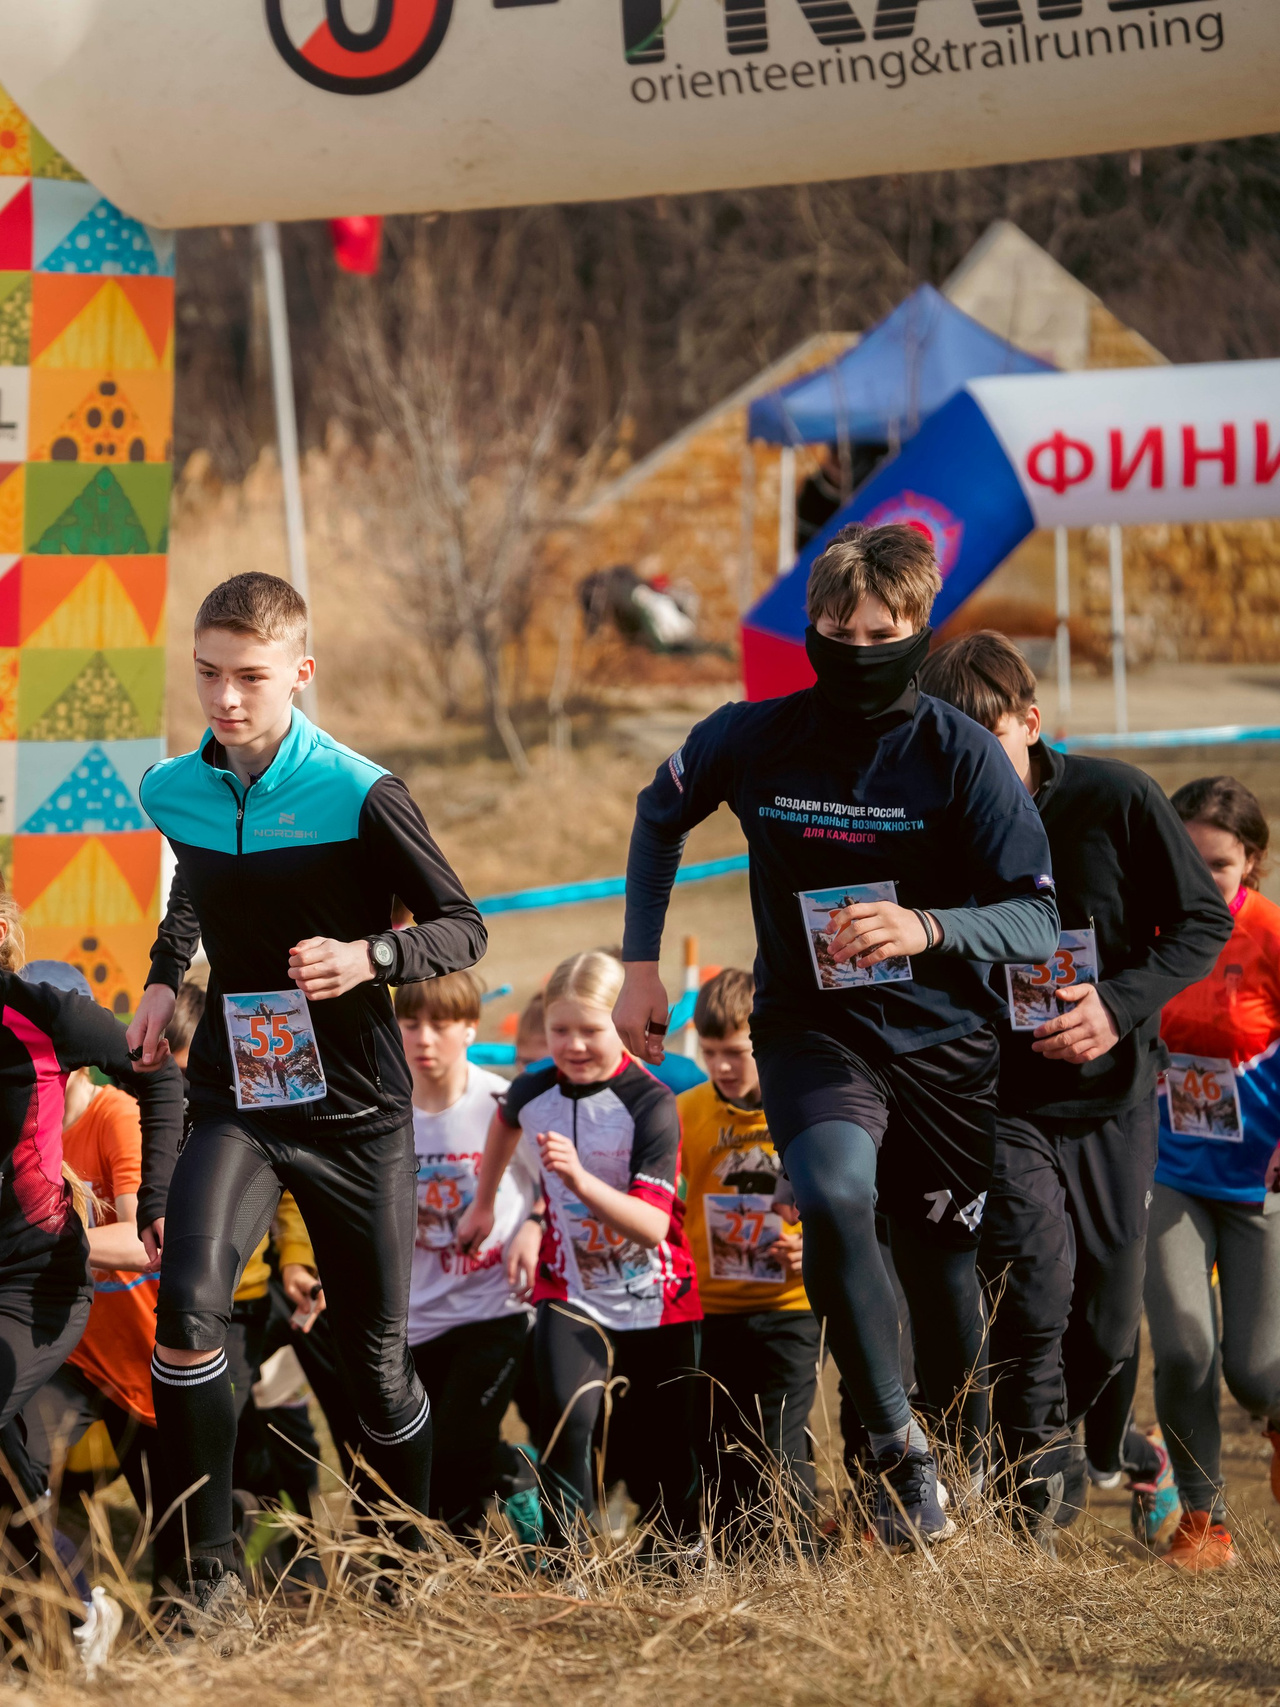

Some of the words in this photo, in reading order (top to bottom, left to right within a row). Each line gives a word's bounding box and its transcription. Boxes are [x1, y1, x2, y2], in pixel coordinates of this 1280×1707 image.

[630, 11, 1226, 104] orienteering&trailrunning
[758, 806, 809, 824] ОТКРЫВАЯ
[811, 814, 850, 829] РАВНЫЕ
[852, 819, 925, 832] ВОЗМОЖНОСТИ
[774, 795, 821, 812] СОЗДАЕМ
[822, 802, 866, 817] БУДУЩЕЕ
[867, 806, 907, 819] РОССИИ,
[253, 828, 319, 839] NORDSKI
[803, 827, 824, 839] ДЛЯ
[826, 829, 877, 843] КАЖДОГО!
[249, 1015, 295, 1058] 55
[1183, 1069, 1222, 1101] 46
[425, 1179, 461, 1210] 43
[724, 1212, 766, 1245] 27
